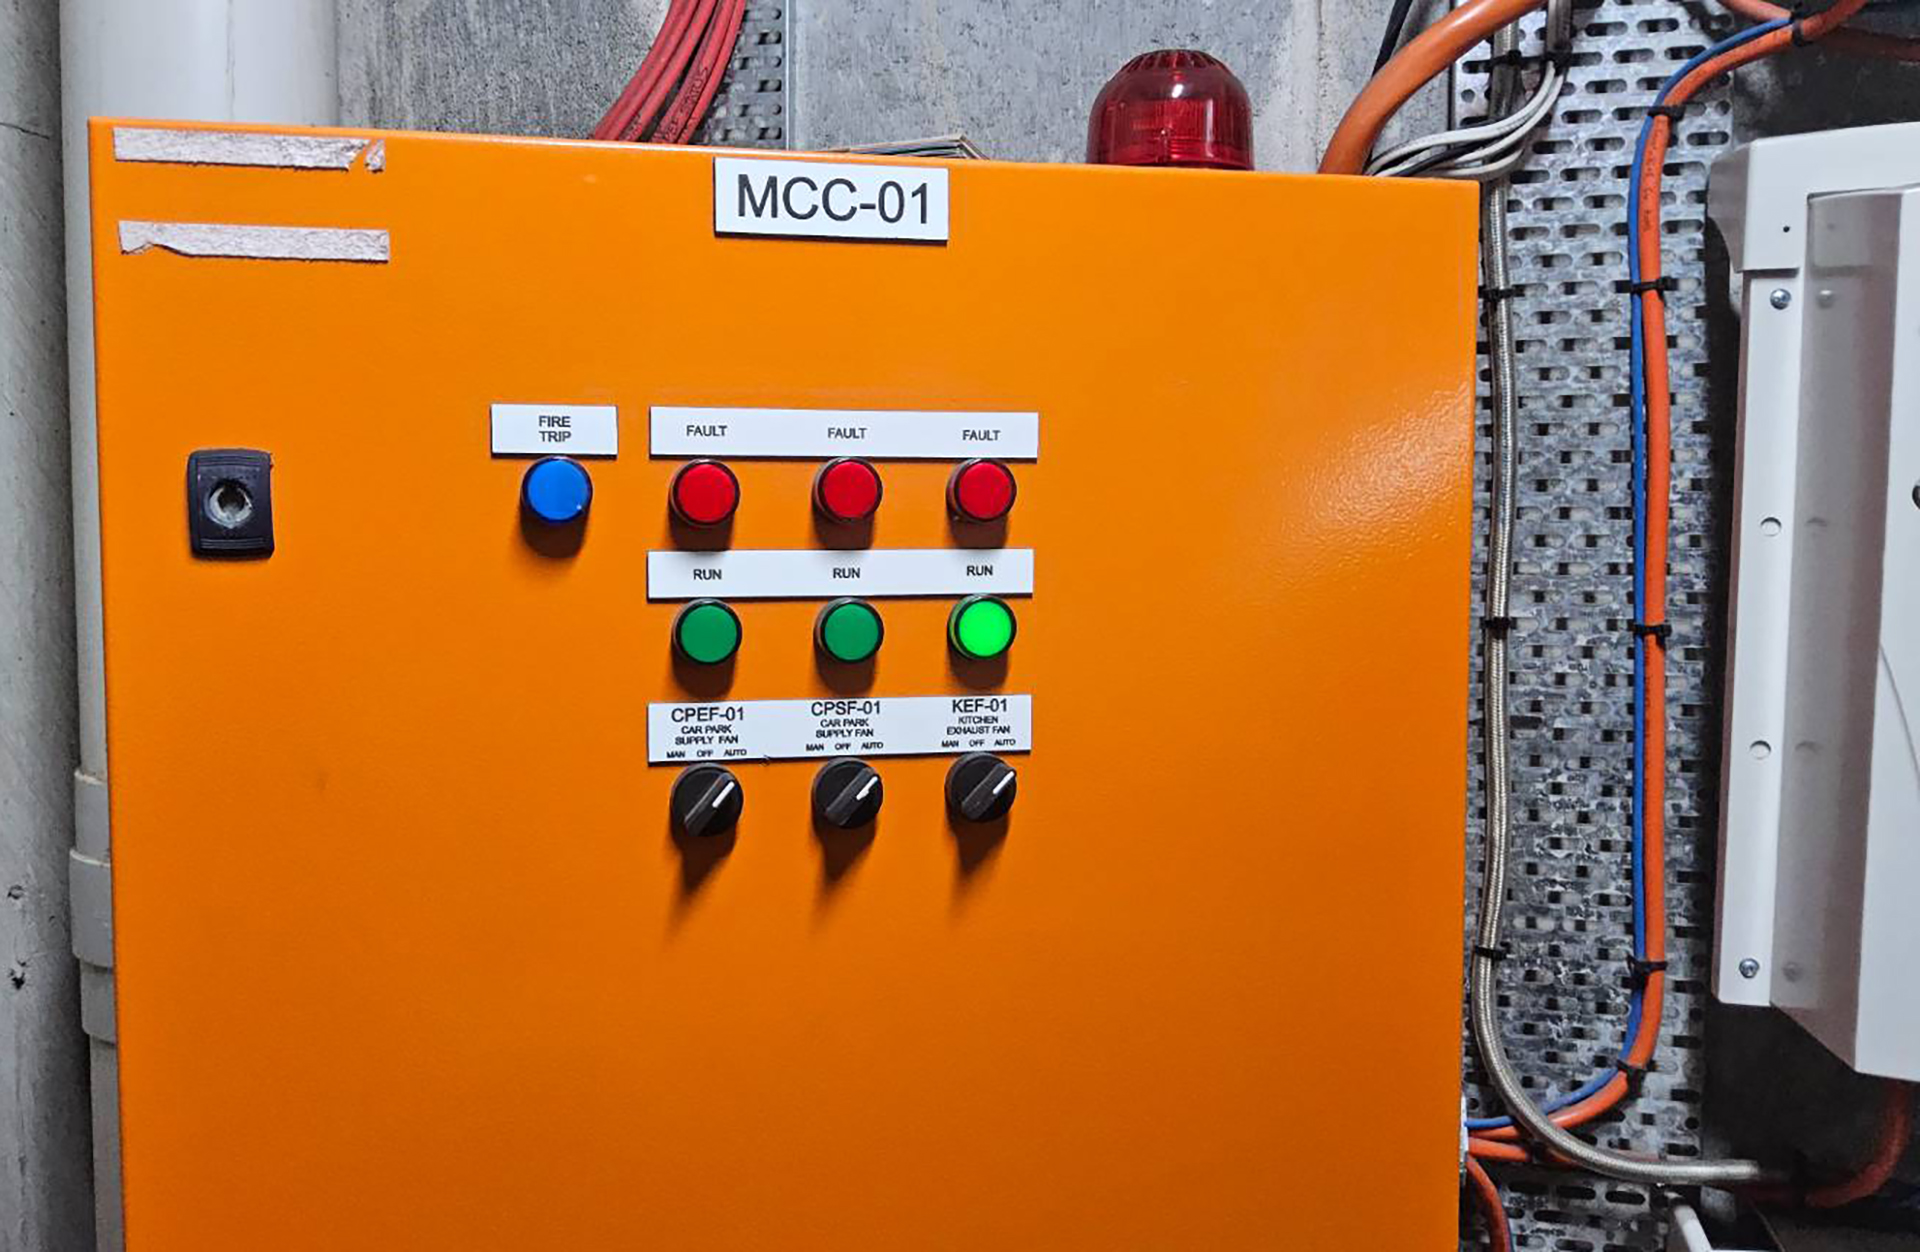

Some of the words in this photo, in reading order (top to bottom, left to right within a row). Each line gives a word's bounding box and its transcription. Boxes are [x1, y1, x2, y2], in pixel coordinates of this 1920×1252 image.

[737, 173, 930, 225] MCC-01
[538, 415, 571, 428] FIRE
[686, 424, 728, 437] FAULT
[827, 427, 867, 439] FAULT
[962, 429, 1001, 441] FAULT
[538, 430, 572, 443] TRIP
[692, 568, 722, 581] RUN
[832, 567, 861, 579] RUN
[966, 564, 994, 577] RUN
[810, 700, 881, 717] CPSF-01
[951, 697, 1008, 714] KEF-01
[670, 706, 745, 723] CPEF-01
[957, 715, 999, 725] KITCHEN
[819, 719, 842, 729] CAR
[842, 718, 870, 728] PARK
[681, 725, 703, 735] CAR
[704, 724, 733, 734] PARK
[815, 729, 853, 739] SUPPLY
[854, 728, 875, 738] FAN
[946, 726, 990, 736] EXHAUST
[991, 725, 1011, 734] FAN
[674, 735, 714, 746] SUPPLY
[718, 735, 739, 745] FAN
[860, 741, 884, 750] AUTO
[940, 740, 960, 748] MAN
[968, 739, 986, 747] OFF
[993, 738, 1017, 747] AUTO
[805, 743, 825, 752] MAN
[834, 742, 852, 751] OFF
[666, 750, 686, 759] MAN
[696, 749, 714, 758] OFF
[723, 748, 748, 757] AUTO
